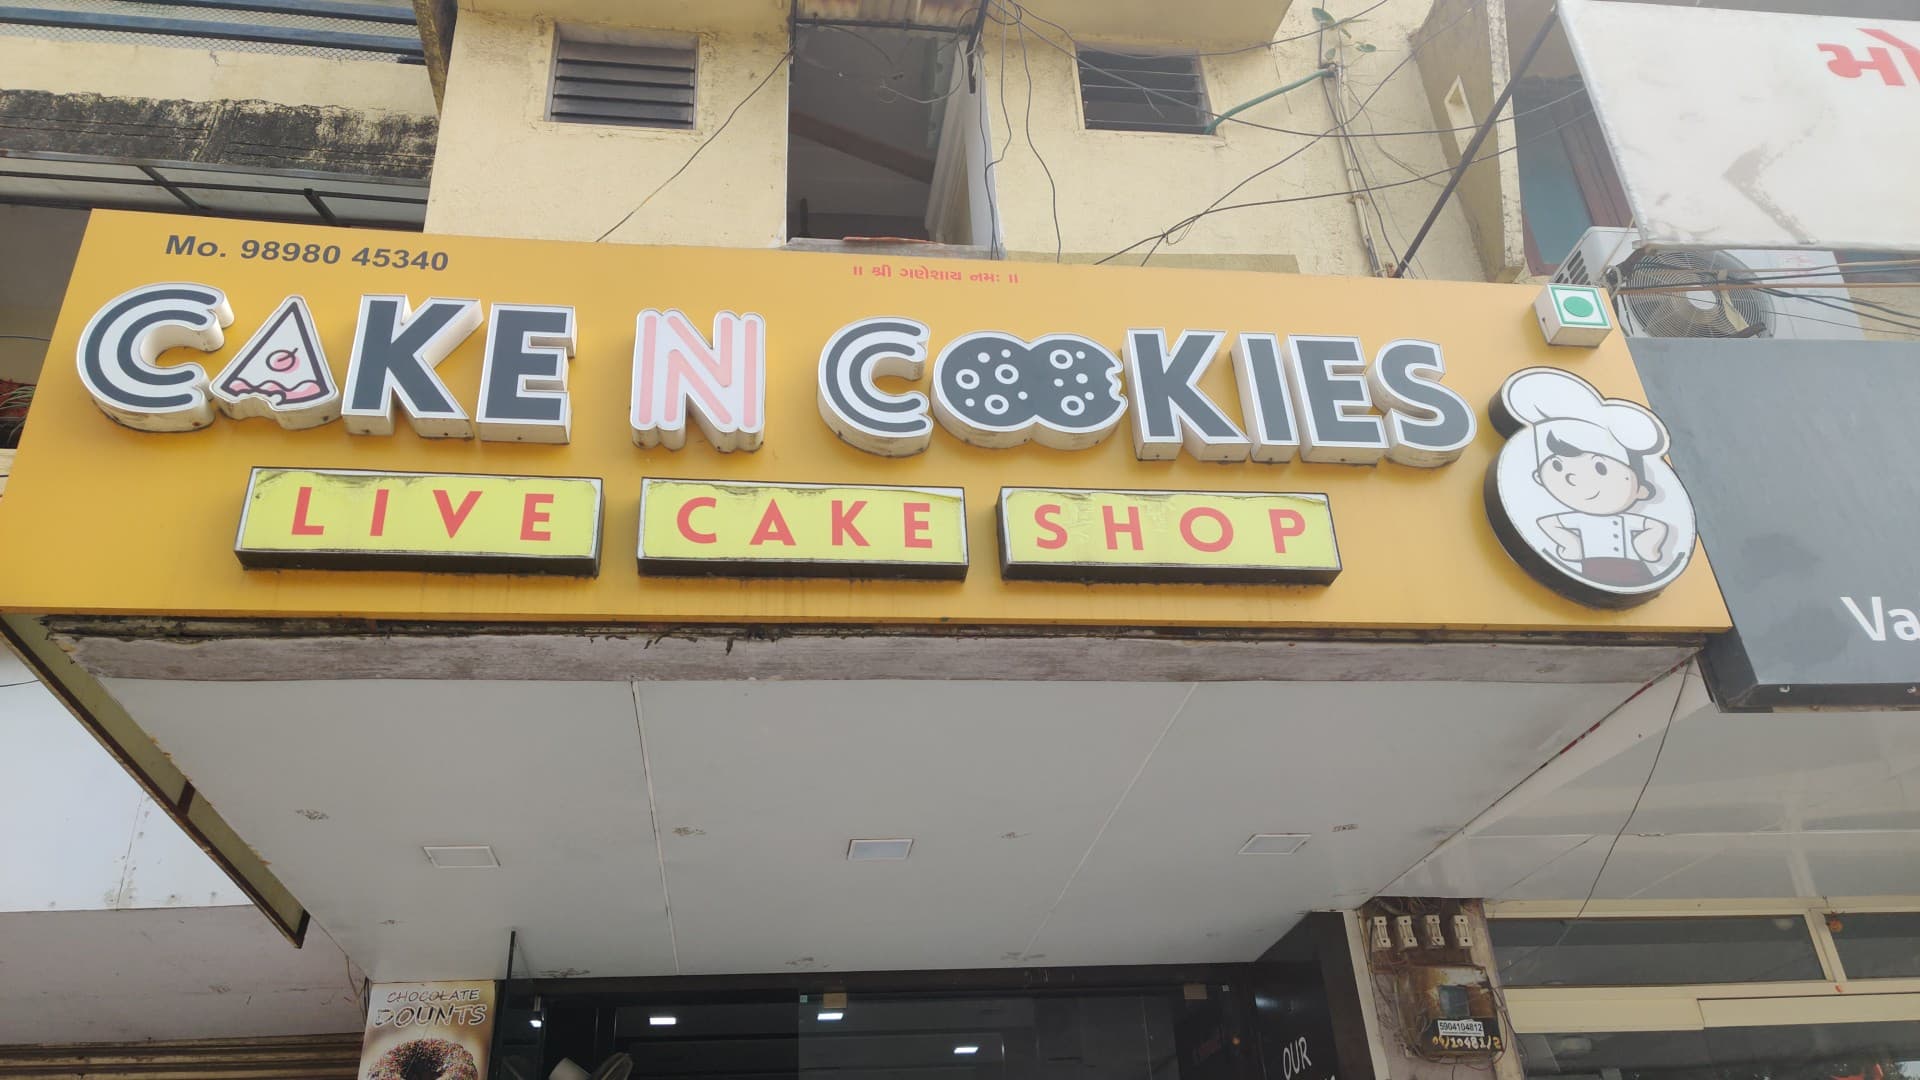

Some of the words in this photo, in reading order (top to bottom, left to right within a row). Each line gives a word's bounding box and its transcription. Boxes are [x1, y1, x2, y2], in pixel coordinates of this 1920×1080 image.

[166, 233, 228, 259] Mo.
[240, 238, 342, 265] 98980
[351, 246, 450, 271] 45340
[872, 264, 892, 278] શ્રી
[900, 266, 962, 281] ગણેશાય
[76, 281, 577, 445] CAKE
[630, 309, 767, 452] N
[817, 317, 1477, 468] COOKIES
[291, 486, 555, 541] LIVE
[677, 497, 934, 549] CAKE
[1036, 504, 1307, 554] SHOP
[1840, 596, 1920, 641] Va
[387, 989, 480, 1003] CHOCOLATE
[375, 1004, 487, 1028] DOUNTS
[1440, 1022, 1483, 1032] 5904104812
[1283, 1036, 1312, 1080] OUR
